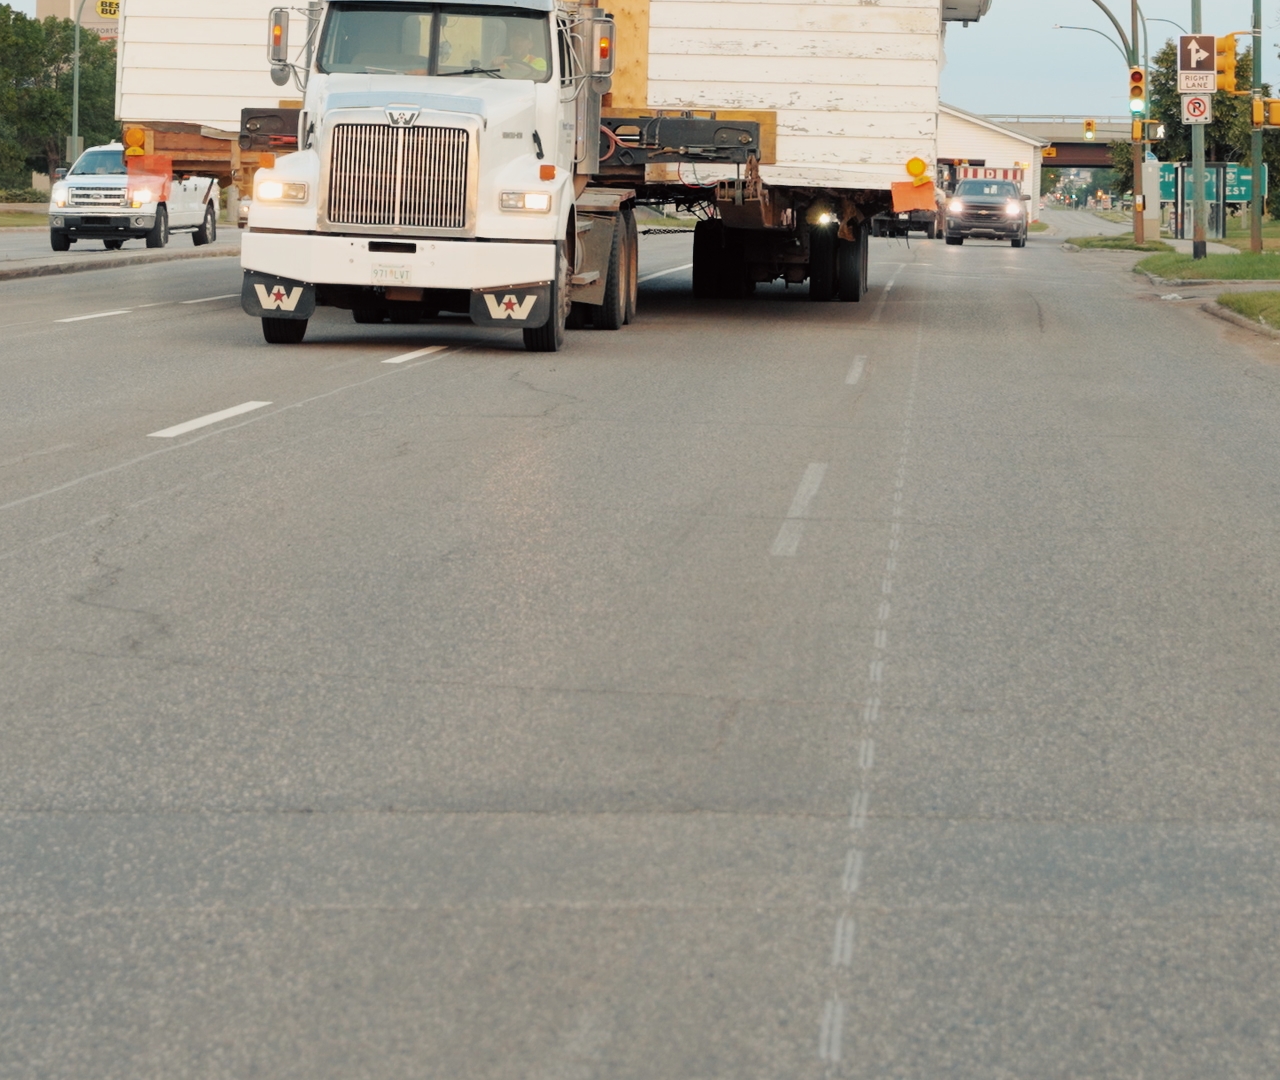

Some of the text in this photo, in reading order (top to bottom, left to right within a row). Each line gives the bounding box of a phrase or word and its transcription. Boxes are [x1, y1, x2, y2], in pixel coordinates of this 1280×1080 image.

[1184, 74, 1209, 82] RIGHT
[985, 170, 995, 178] D
[373, 268, 388, 279] 971
